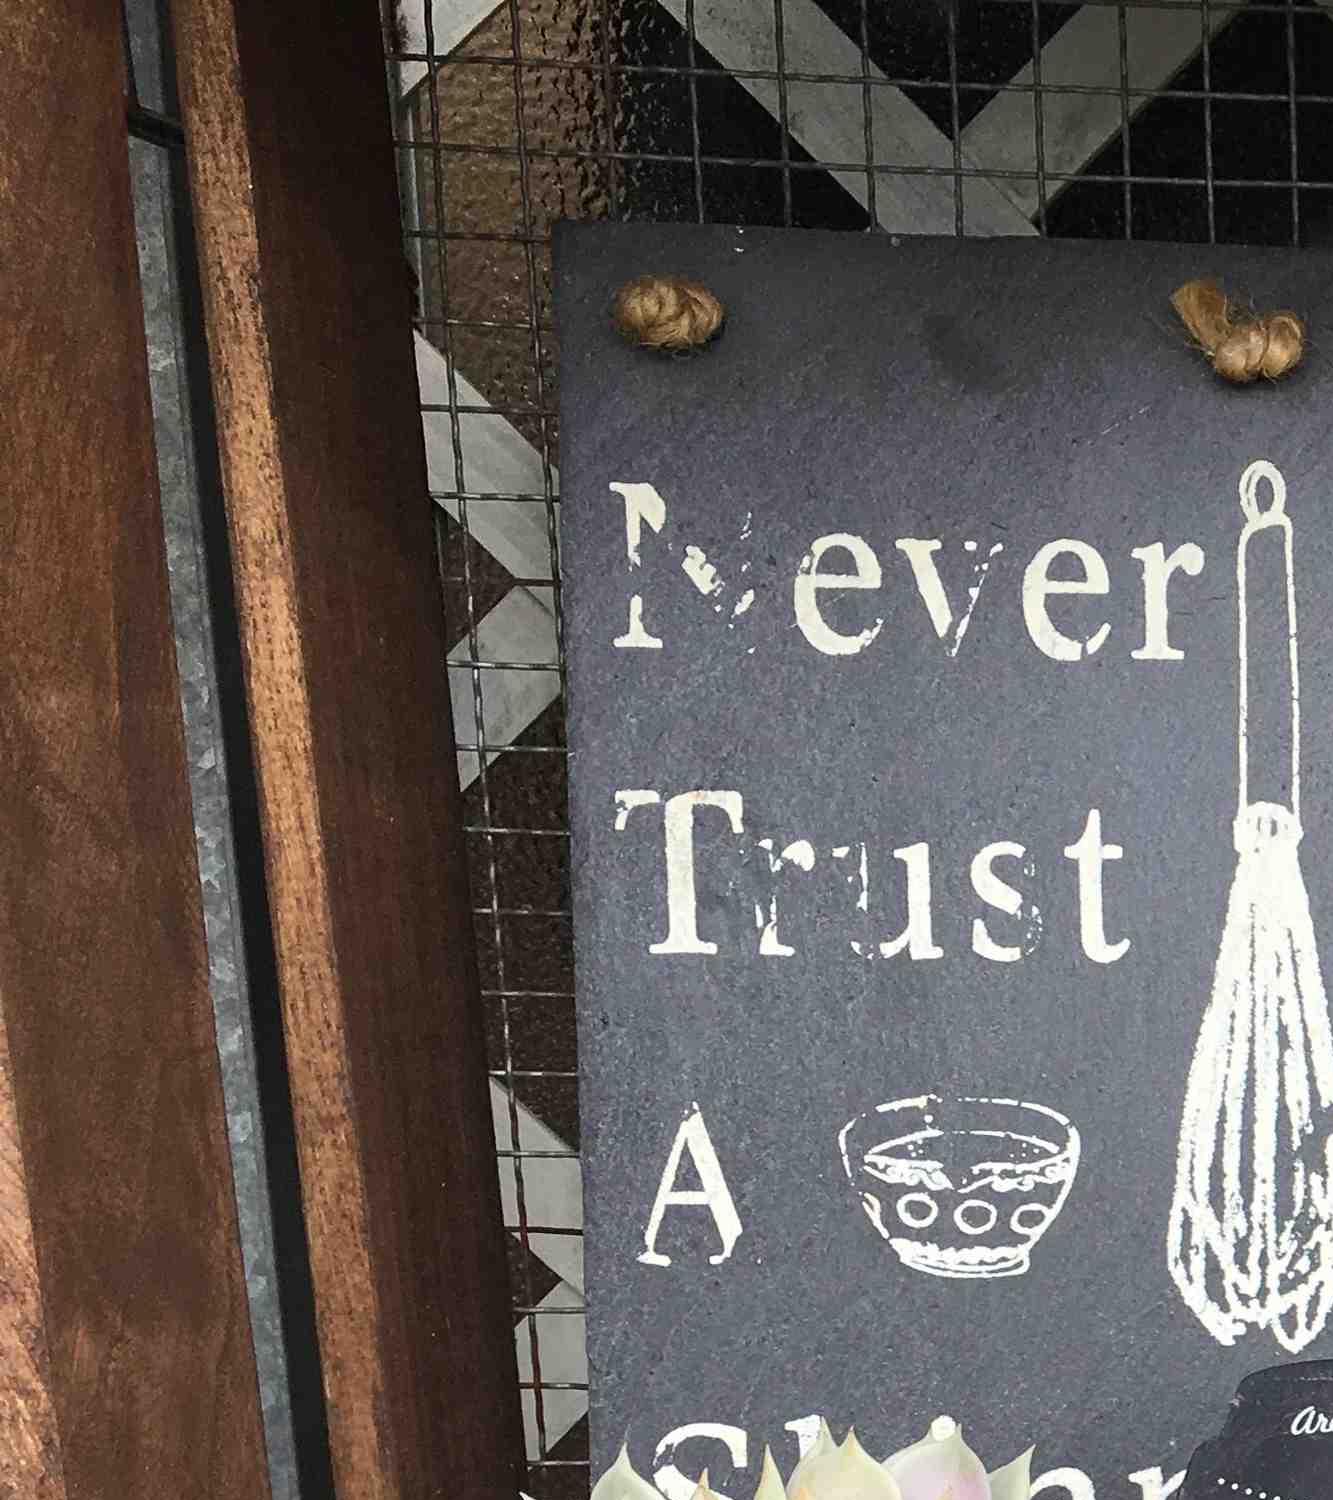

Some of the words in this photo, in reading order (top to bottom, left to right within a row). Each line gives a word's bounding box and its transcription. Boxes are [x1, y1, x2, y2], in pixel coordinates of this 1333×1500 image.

[609, 481, 1205, 662] Never
[614, 789, 1132, 965] Trust
[636, 1100, 743, 1267] A
